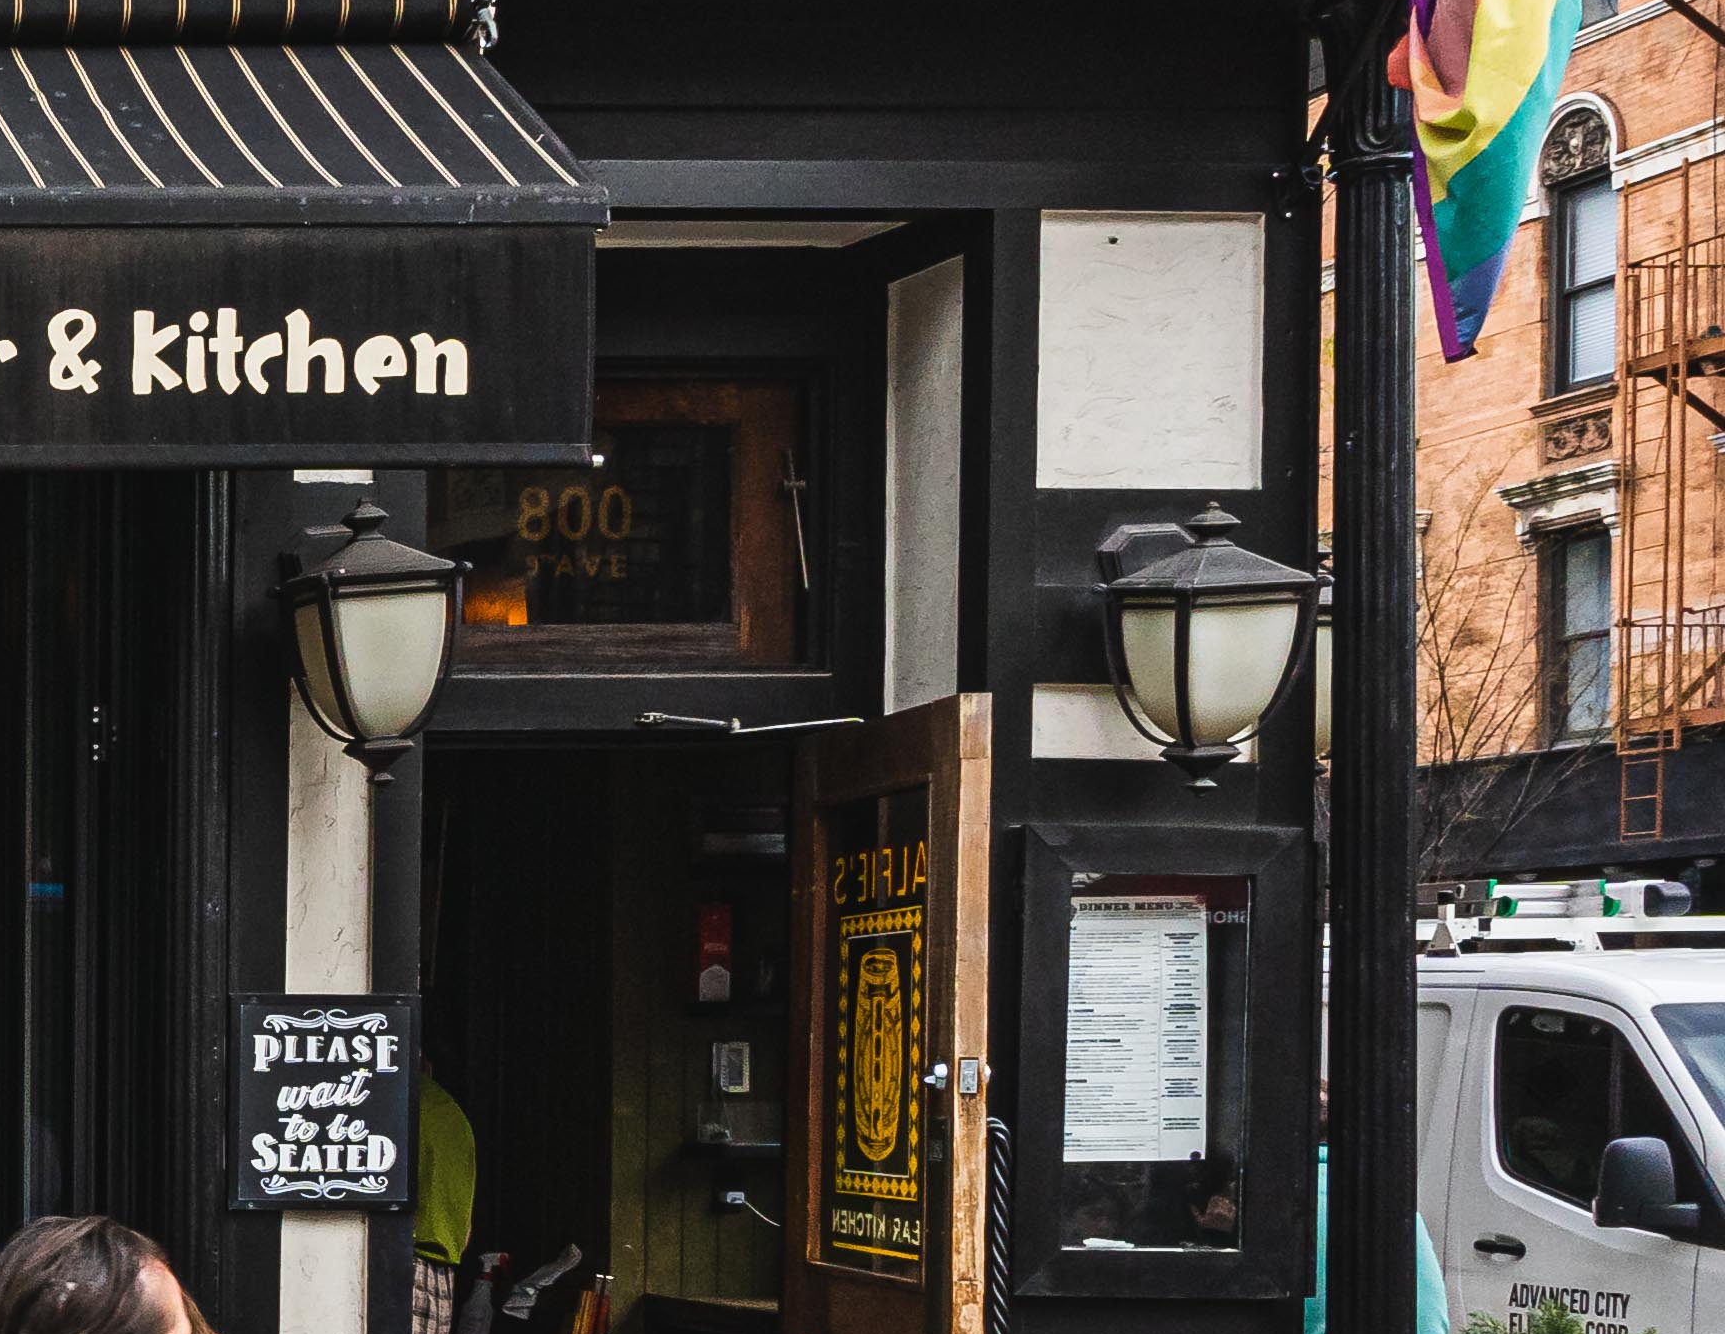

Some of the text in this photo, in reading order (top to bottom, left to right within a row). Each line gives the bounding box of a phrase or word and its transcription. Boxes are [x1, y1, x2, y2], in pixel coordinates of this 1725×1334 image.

[49, 308, 102, 396] &
[133, 306, 469, 396] kitchen
[516, 485, 633, 542] 800
[1134, 901, 1174, 911] MENU
[252, 1034, 399, 1073] PLEASE
[277, 1068, 372, 1111] wait
[278, 1113, 370, 1143] to be
[250, 1133, 398, 1173] SEATED
[1508, 1282, 1631, 1319] ADVANCED CITY
